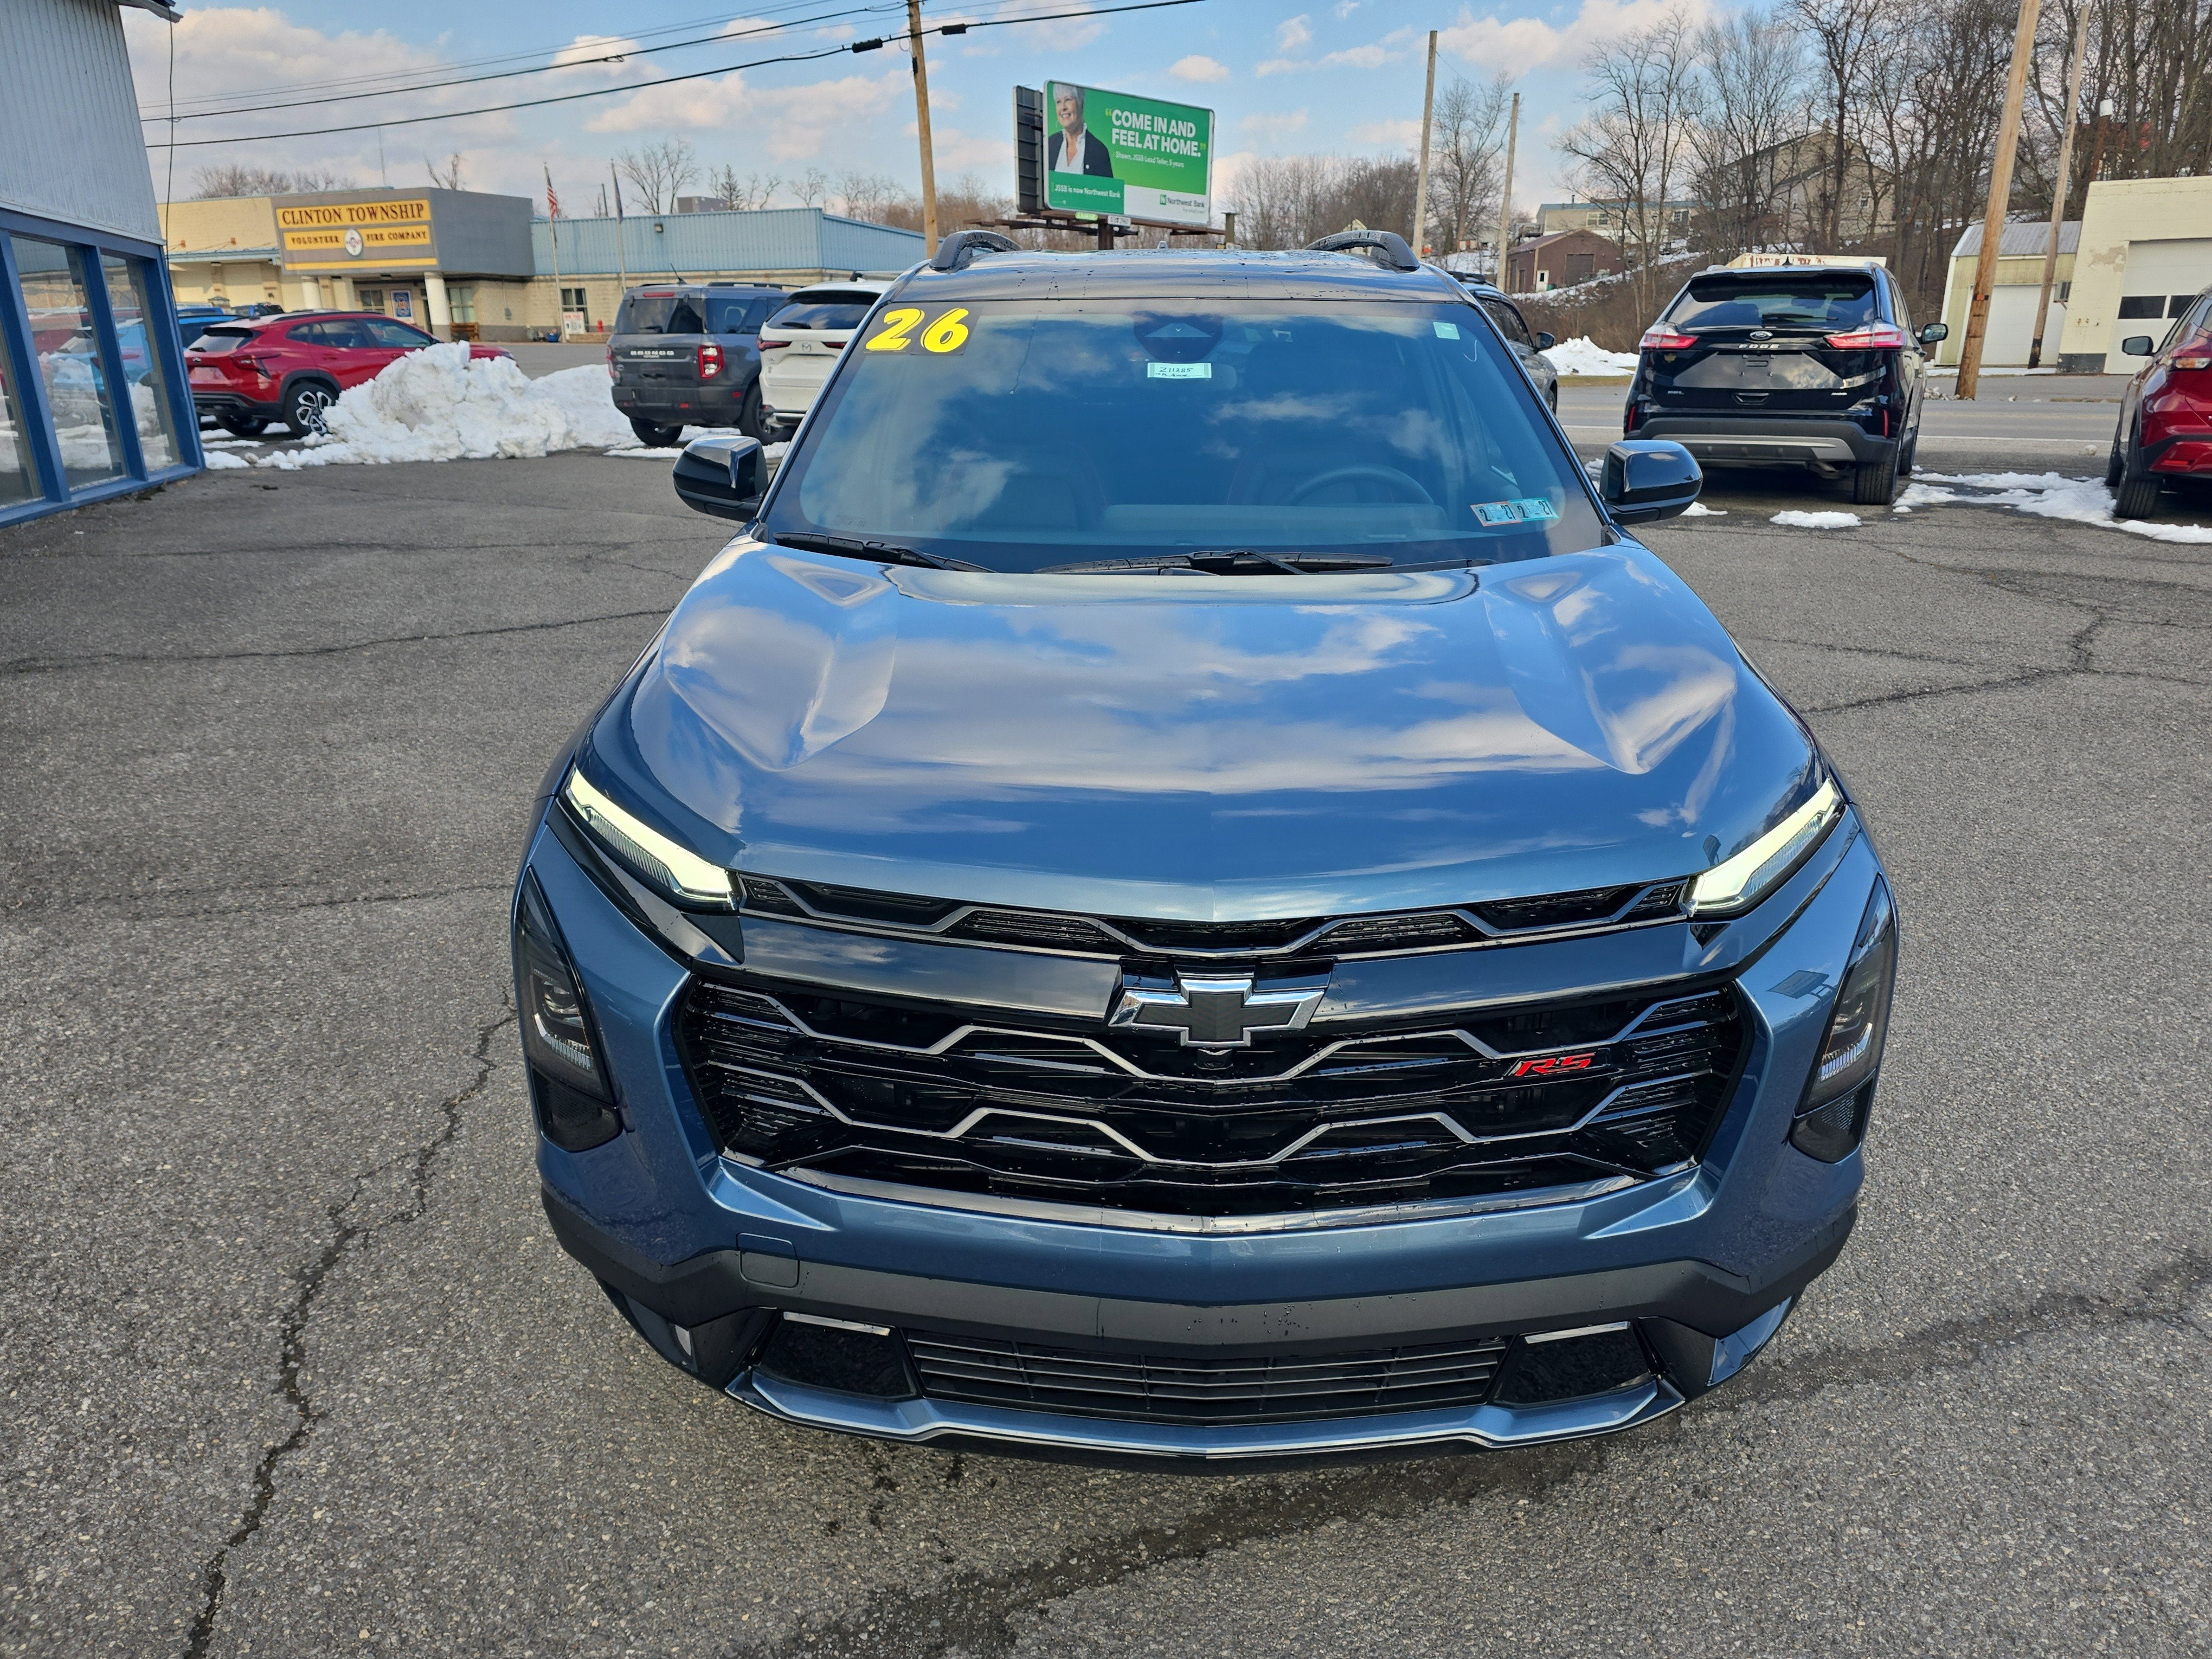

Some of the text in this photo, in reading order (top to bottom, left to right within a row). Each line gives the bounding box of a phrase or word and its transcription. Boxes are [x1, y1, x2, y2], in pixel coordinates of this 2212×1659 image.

[1154, 116, 1167, 133] IN
[1168, 119, 1196, 138] AND
[1111, 128, 1142, 148] FEEL
[1143, 134, 1160, 151] AT
[282, 203, 424, 225] CLINTON TOWNSHIP
[291, 230, 427, 245] VOLUNTEER FIRE COMPANY
[866, 307, 969, 352] 26
[1514, 1052, 1596, 1076] RS
